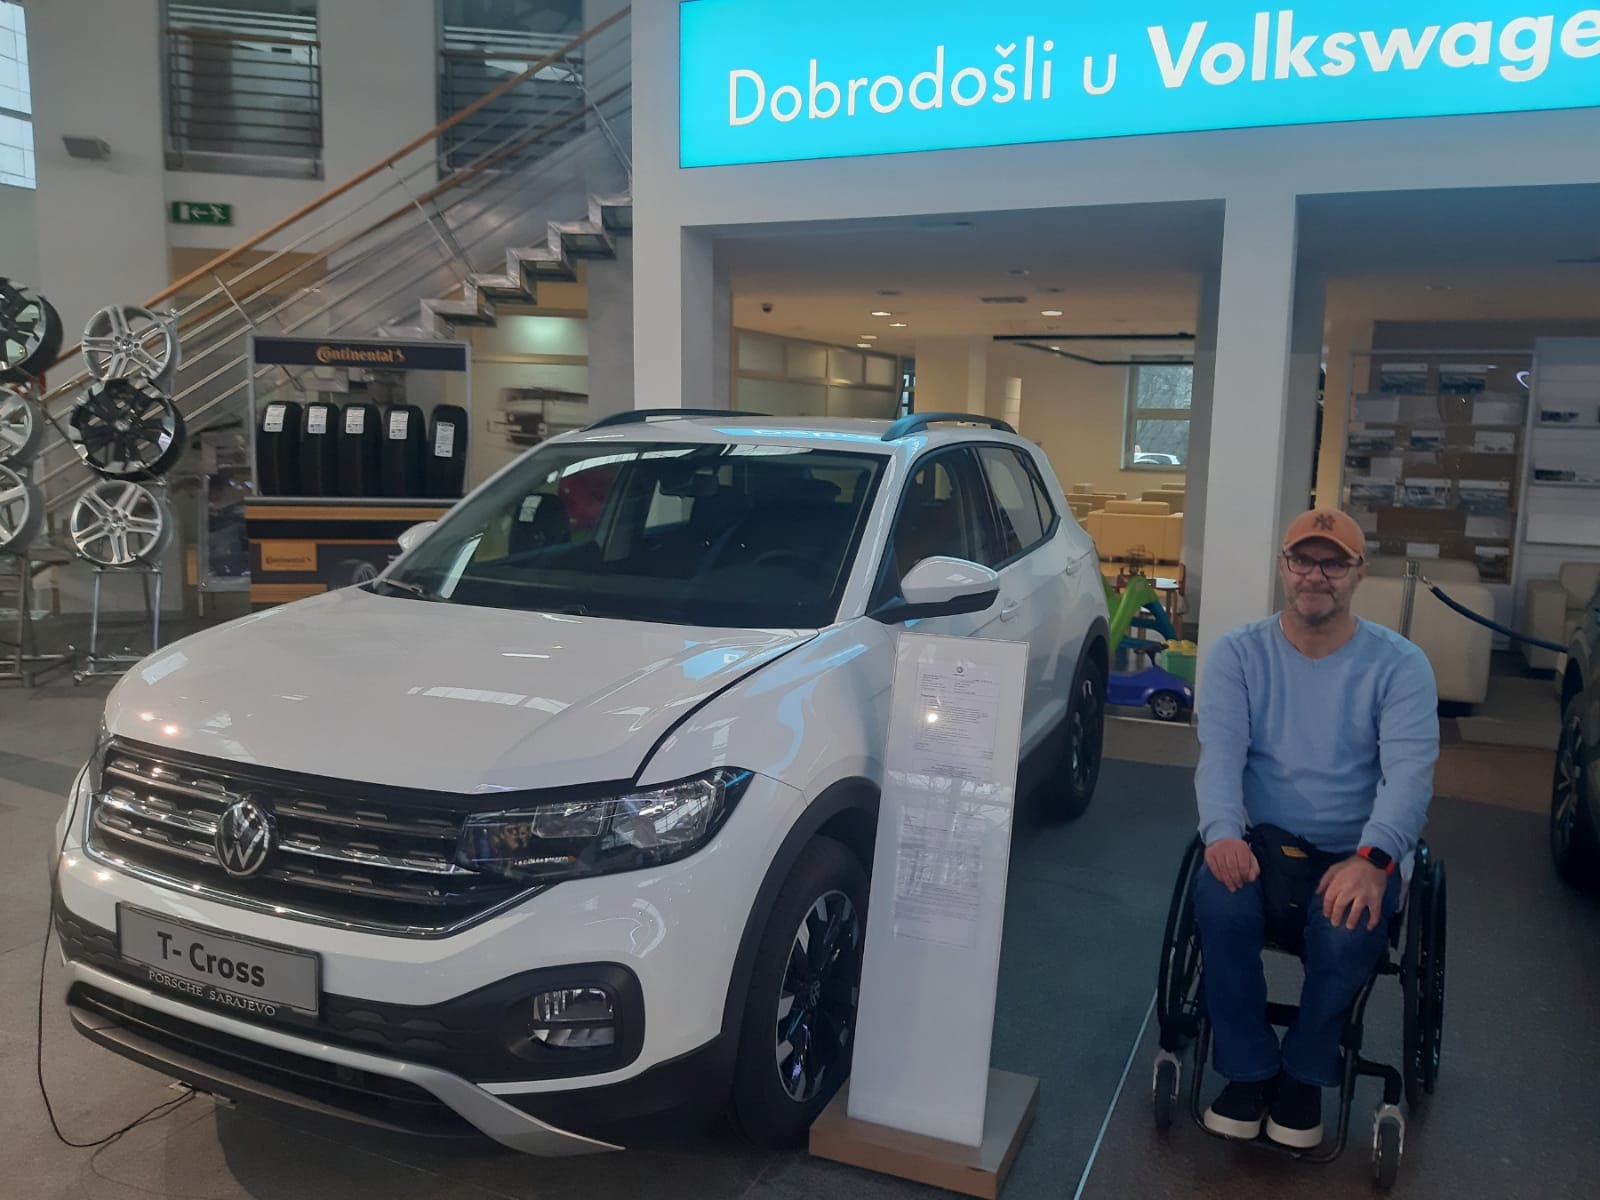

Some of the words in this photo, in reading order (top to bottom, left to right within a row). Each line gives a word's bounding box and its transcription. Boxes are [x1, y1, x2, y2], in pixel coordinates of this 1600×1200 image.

[728, 34, 1054, 128] Dobrodošli
[1083, 53, 1118, 96] u
[316, 346, 394, 363] Continental
[189, 942, 265, 988] Cross
[148, 970, 204, 996] PORSCHE
[209, 989, 276, 1017] SARAJEVO
